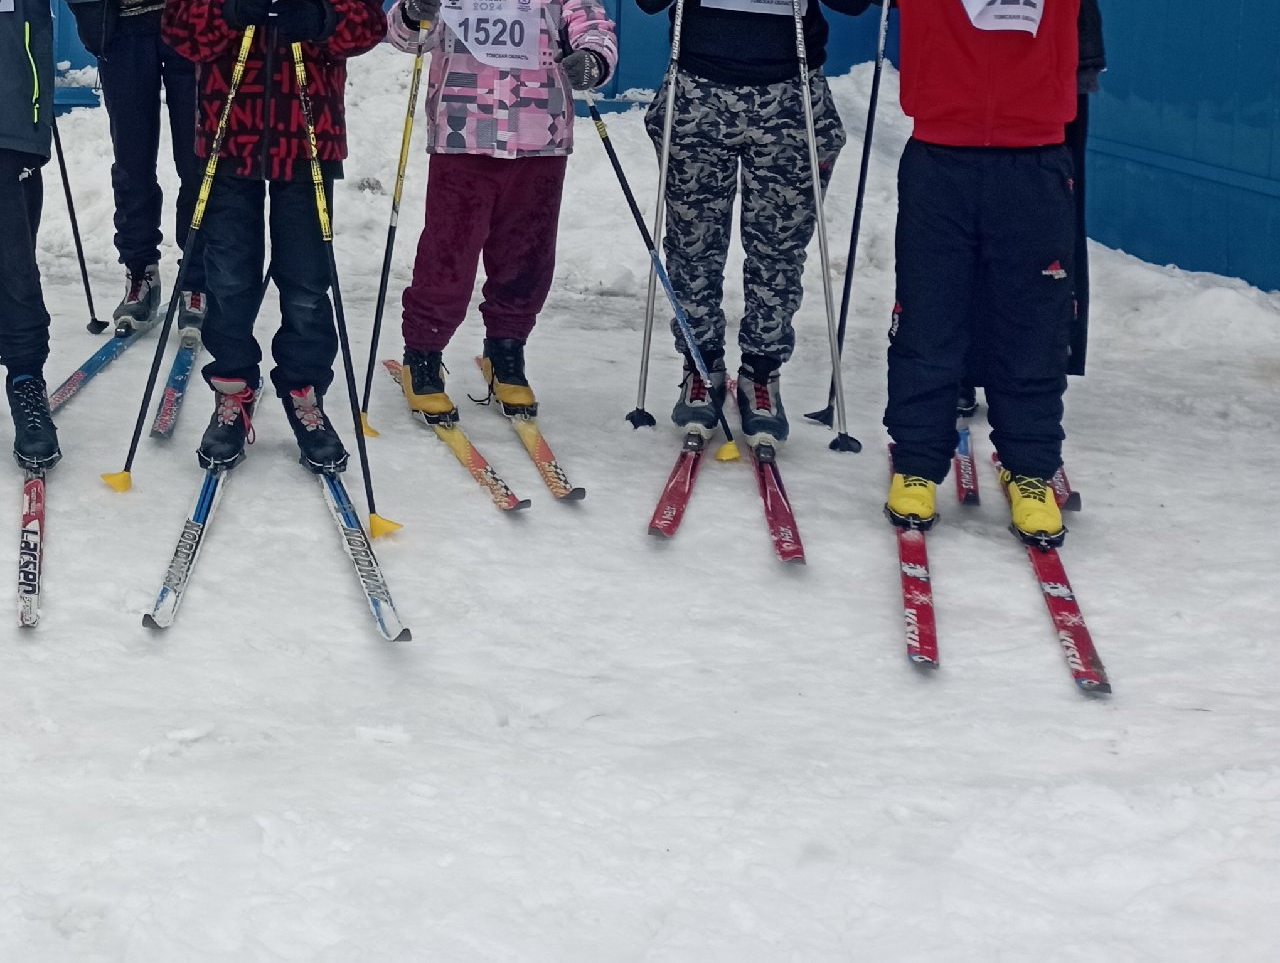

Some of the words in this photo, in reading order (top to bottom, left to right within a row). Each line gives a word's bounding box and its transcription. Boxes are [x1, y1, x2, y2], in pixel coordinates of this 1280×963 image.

[458, 17, 525, 48] 1520
[473, 2, 503, 11] 2024
[19, 529, 39, 595] Larsen
[163, 518, 203, 595] NORDWAY
[342, 526, 390, 604] NORDWAY
